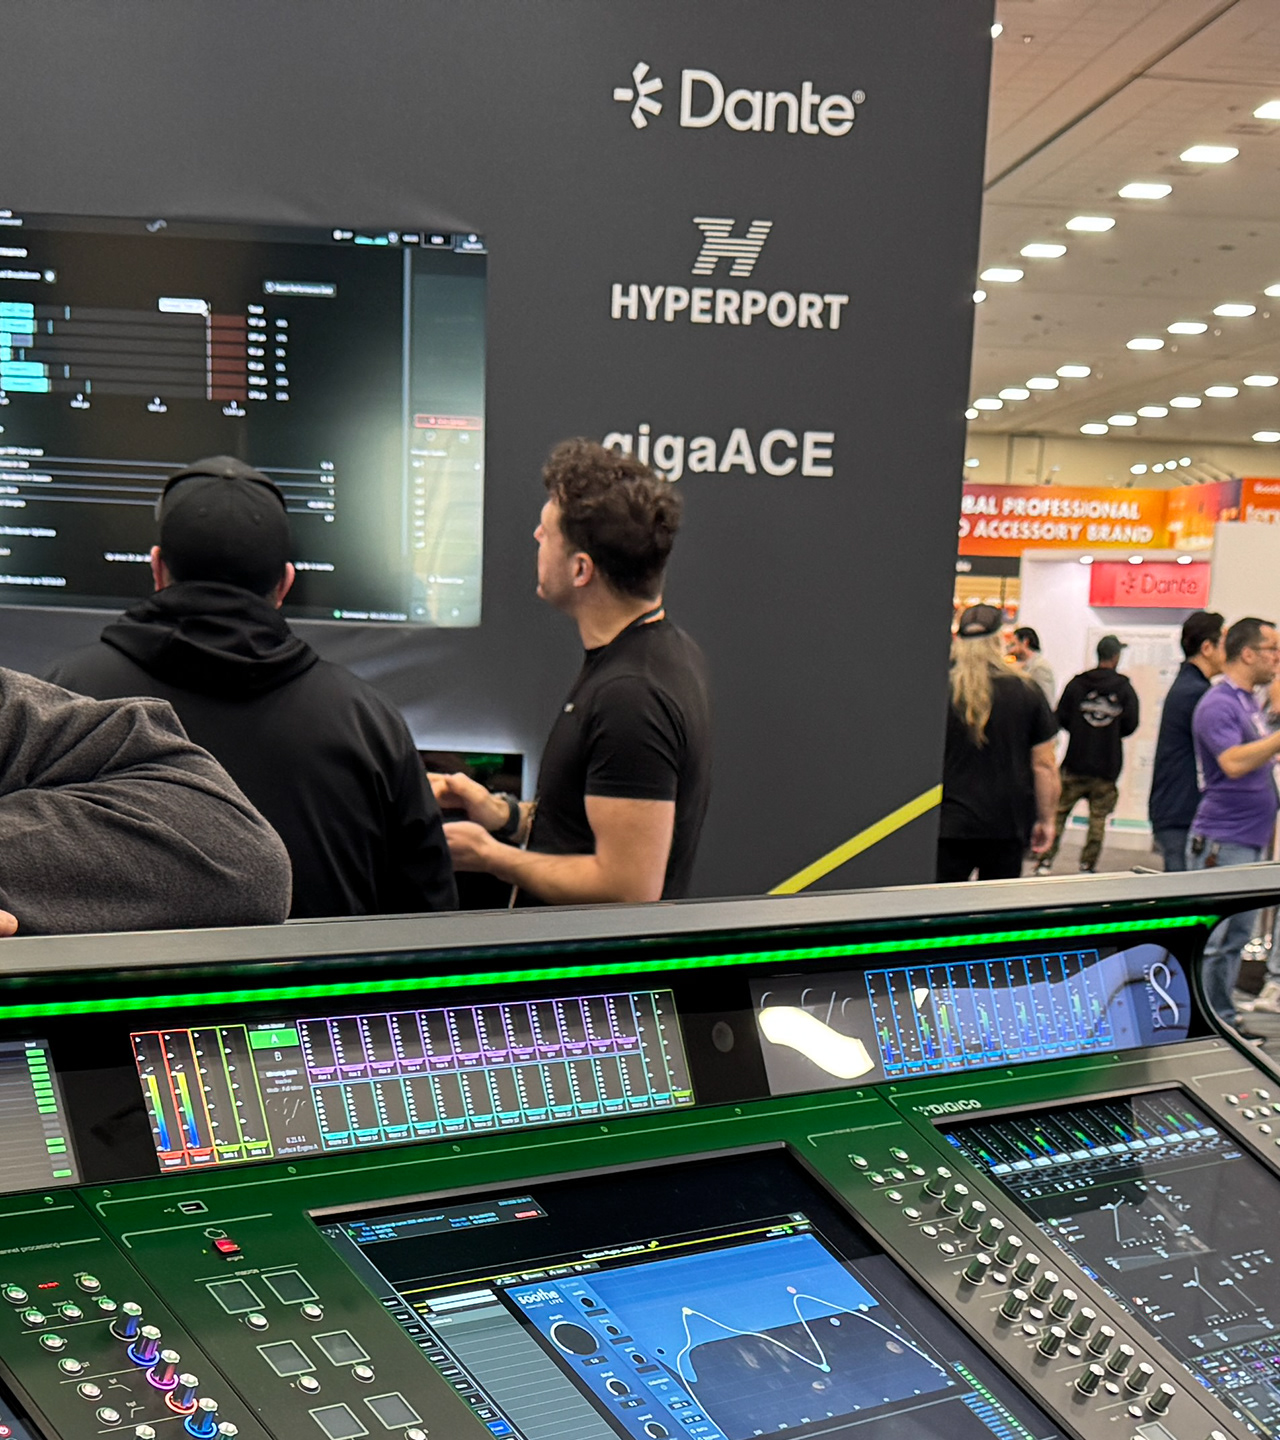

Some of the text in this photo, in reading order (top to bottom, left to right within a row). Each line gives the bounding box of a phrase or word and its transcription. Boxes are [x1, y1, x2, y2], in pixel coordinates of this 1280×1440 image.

[680, 68, 855, 137] Dante
[611, 283, 849, 330] HYPERPORT
[1001, 497, 1140, 520] PROFESSIONAL
[973, 519, 1084, 540] ACCESSORY
[1087, 524, 1154, 543] BRAND
[1140, 573, 1199, 597] Dante
[271, 1034, 279, 1044] A
[274, 1051, 283, 1061] B
[21, 1240, 61, 1254] processing
[517, 1288, 560, 1305] soothe
